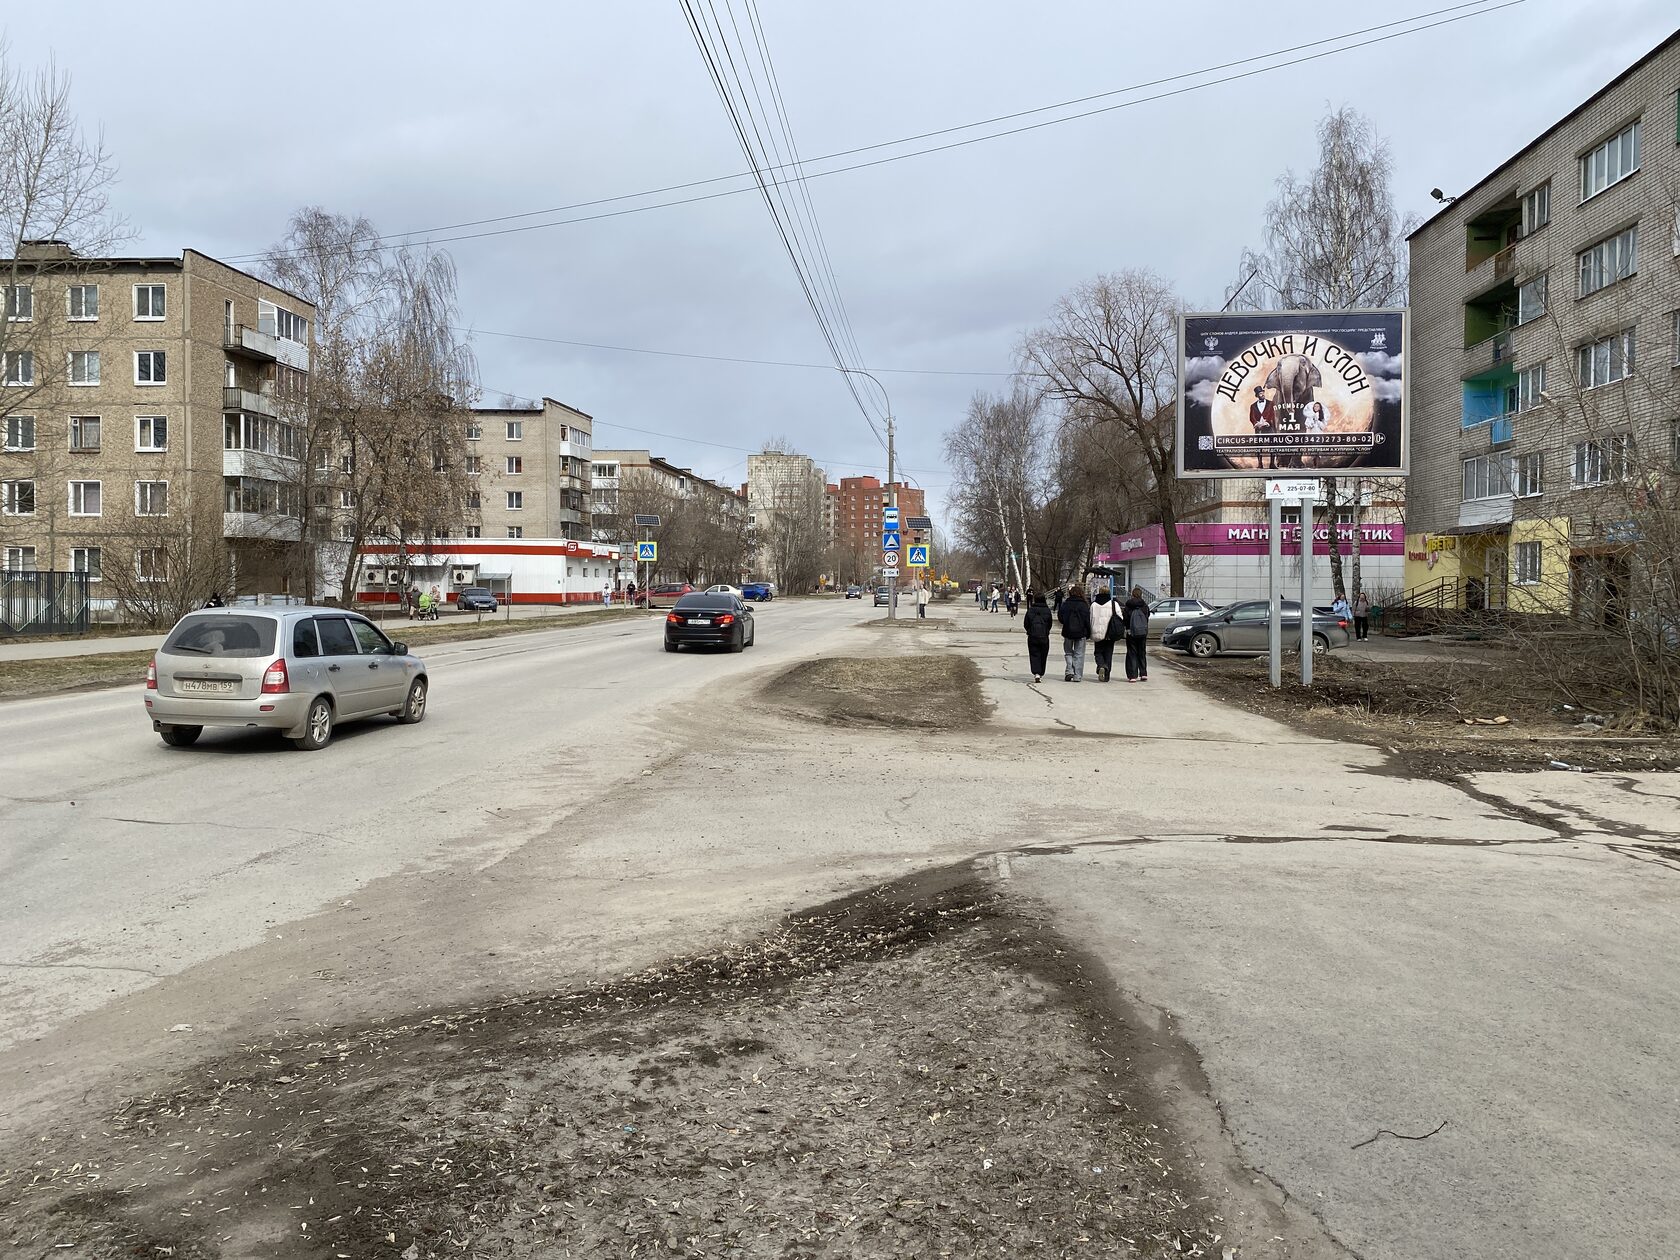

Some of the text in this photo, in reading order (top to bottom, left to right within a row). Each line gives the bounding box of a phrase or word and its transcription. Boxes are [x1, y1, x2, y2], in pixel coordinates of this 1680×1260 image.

[1216, 335, 1370, 402] ДЕВОЧКА И СЛОН
[1288, 412, 1296, 422] 1
[1228, 528, 1290, 540] МАГНТ
[1312, 529, 1392, 540] КОМТИК
[185, 682, 218, 691] Н478МВ
